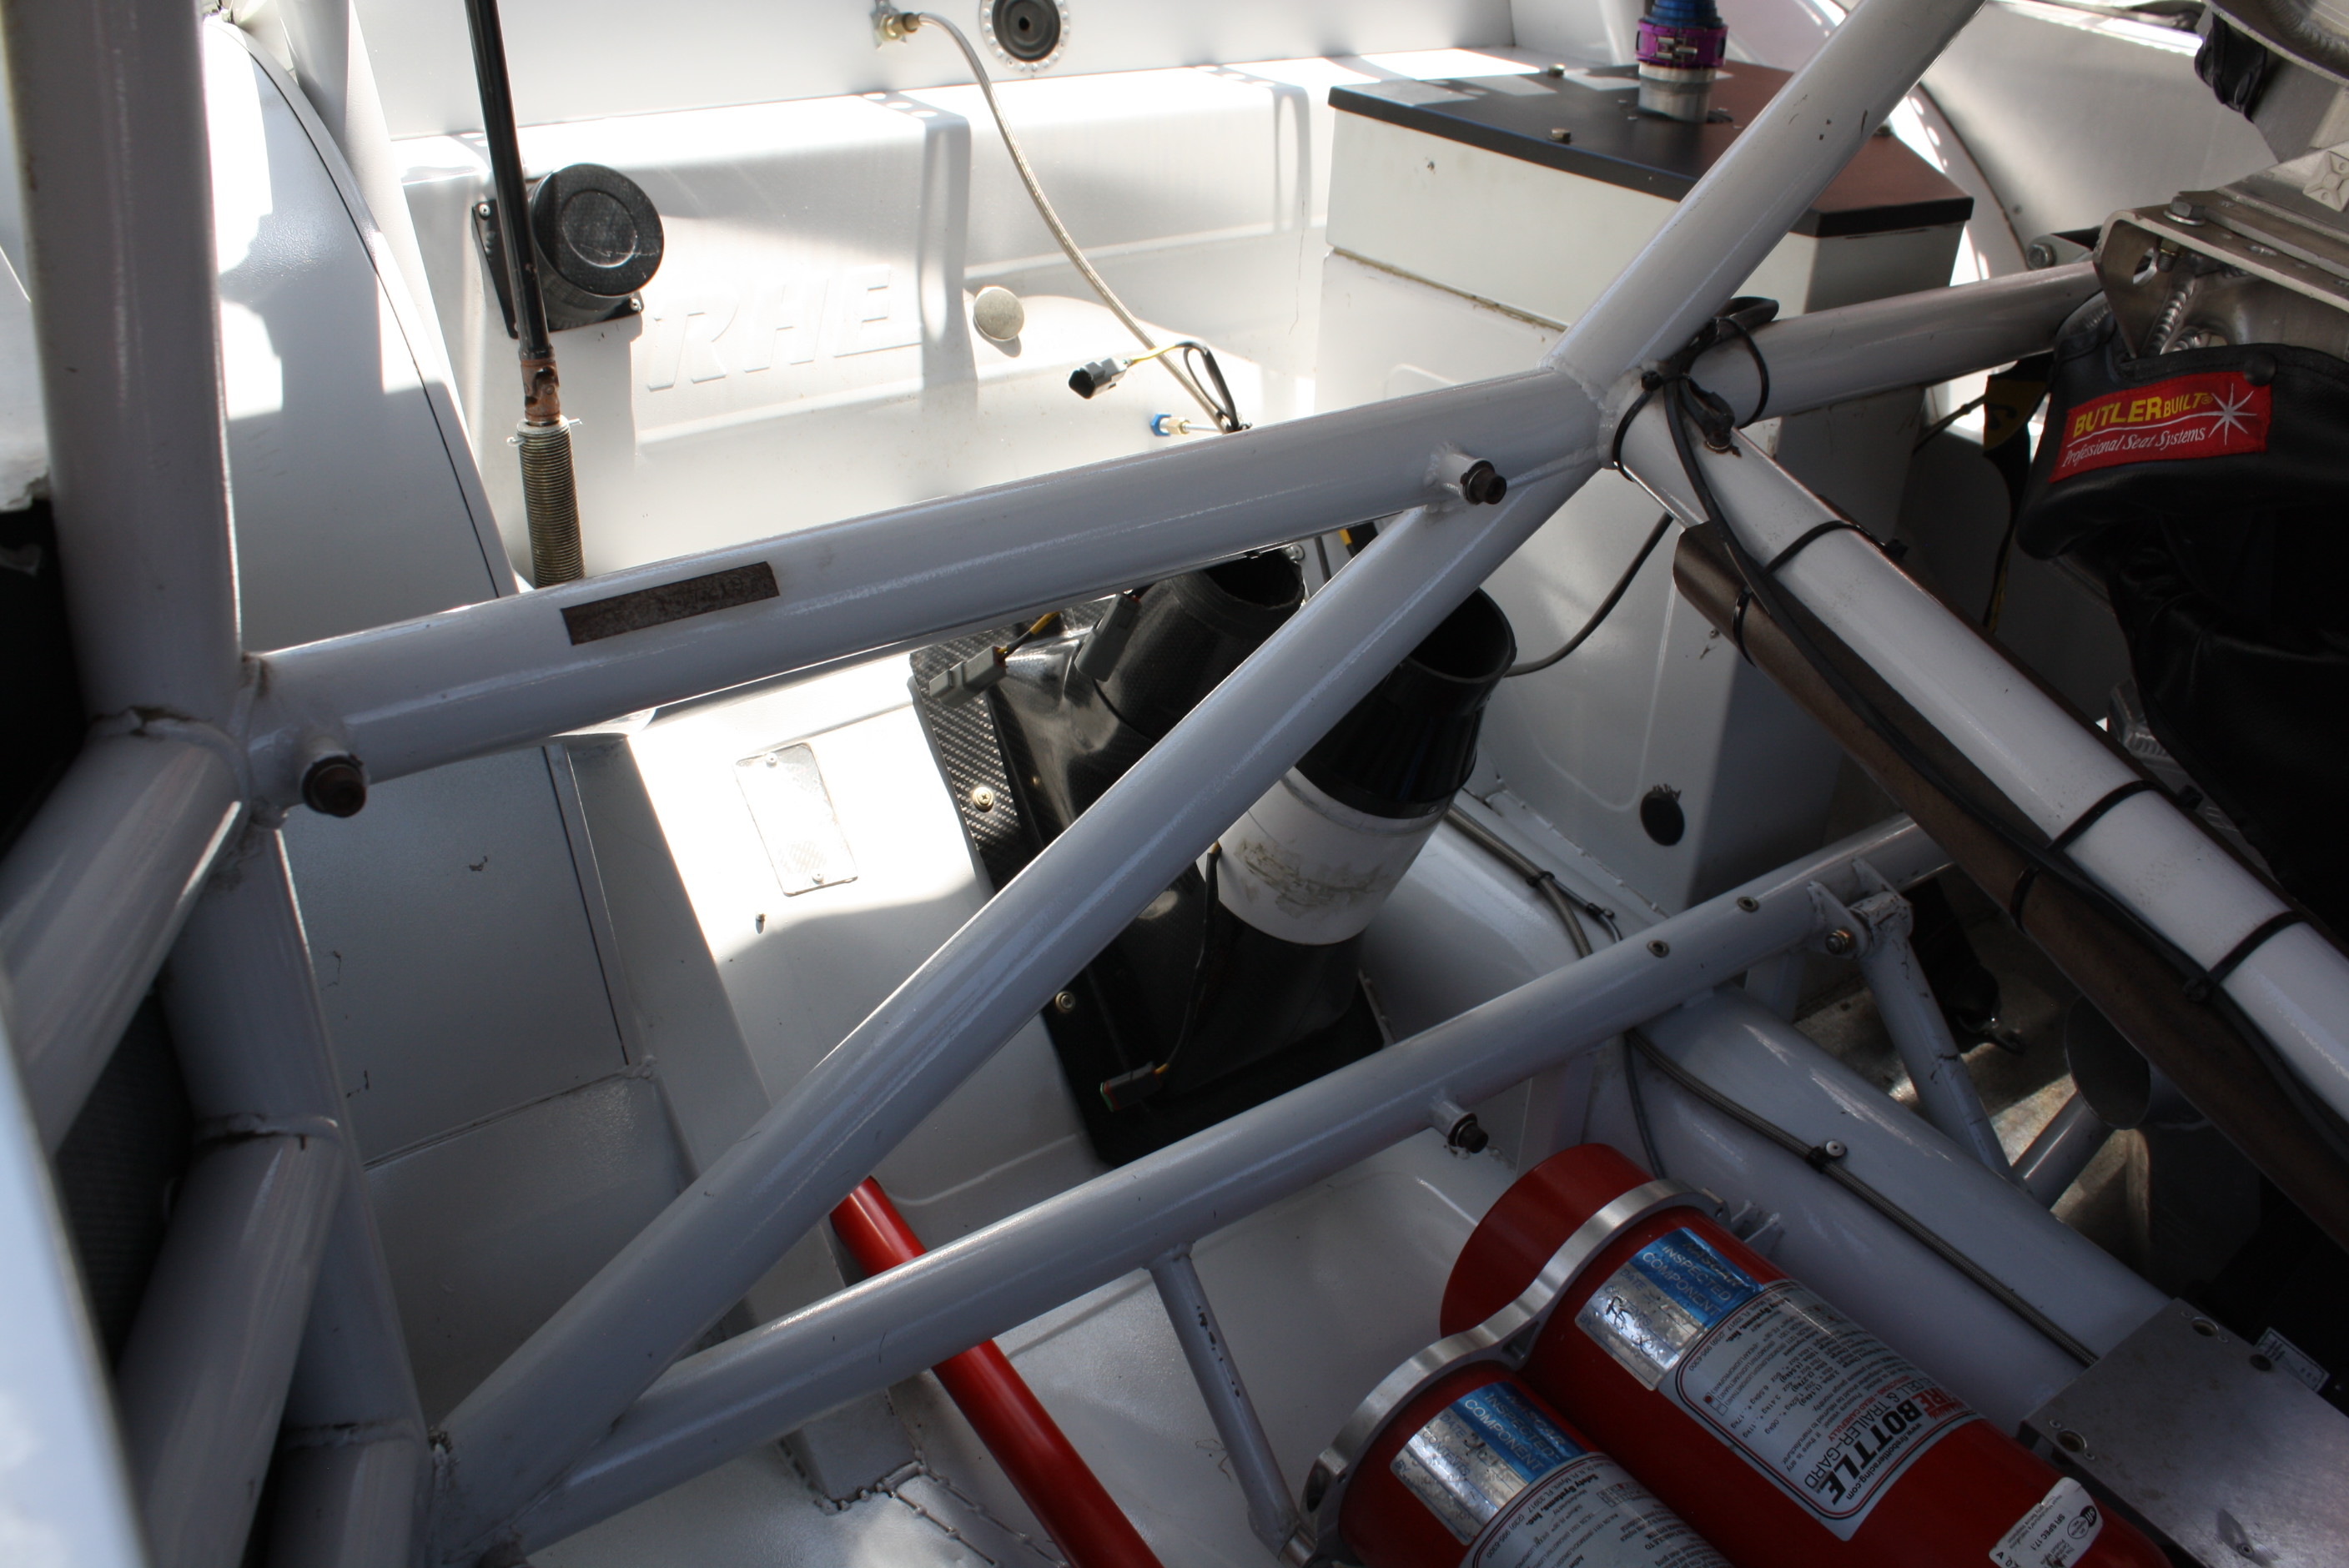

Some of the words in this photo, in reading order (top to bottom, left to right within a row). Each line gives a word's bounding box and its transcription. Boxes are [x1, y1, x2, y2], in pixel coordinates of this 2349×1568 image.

[2062, 438, 2121, 468] Professional
[2122, 434, 2154, 450] Seat
[2155, 427, 2206, 449] Systems
[1661, 1243, 1732, 1303] INSPECTED
[1683, 1237, 1741, 1289] NASCAR
[1641, 1250, 1723, 1319] COMPONENT
[1738, 1307, 1771, 1330] Systems,
[1709, 1331, 1725, 1346] (239)
[1725, 1329, 1742, 1343] Inc.
[1688, 1344, 1712, 1371] 995-6300
[1770, 1371, 1782, 1382] 6oz
[1778, 1361, 1803, 1382] (4.54kg)
[1790, 1370, 1814, 1392] (2.27kg)
[1749, 1385, 1768, 1405] 6.58kg
[1782, 1381, 1792, 1392] 4oz
[1798, 1384, 1822, 1406] (1.14kg)
[1760, 1394, 1781, 1415] 3.41kg
[1858, 1395, 1875, 1410] READ
[1884, 1391, 1900, 1404] &
[1815, 1401, 1837, 1424] returned
[1437, 1411, 1469, 1440] DATE
[1461, 1395, 1543, 1471] COMPONENT
[1483, 1390, 1555, 1457] INSPECTED
[1828, 1408, 1860, 1441] CAREFULLY
[1421, 1427, 1471, 1477] CONTENTS
[1781, 1427, 1812, 1464] manufacturer.
[1801, 1436, 1816, 1452] there
[1819, 1398, 1922, 1505] BOTTLE
[1786, 1460, 1796, 1472] any
[1846, 1421, 1922, 1500] www.firebottleracing.com
[1539, 1485, 1577, 1513] Systems,
[1542, 1488, 1553, 1498] FL
[1527, 1495, 1546, 1513] 33917
[1507, 1512, 1526, 1531] (239)
[1525, 1511, 1543, 1528] Inc.
[2052, 1512, 2065, 1525] SFI
[2039, 1521, 2057, 1540] SPEC
[1486, 1530, 1511, 1558] 995-6300
[2029, 1537, 2043, 1551] 17.1
[2050, 1537, 2065, 1554] Product
[1995, 1550, 2005, 1560] A
